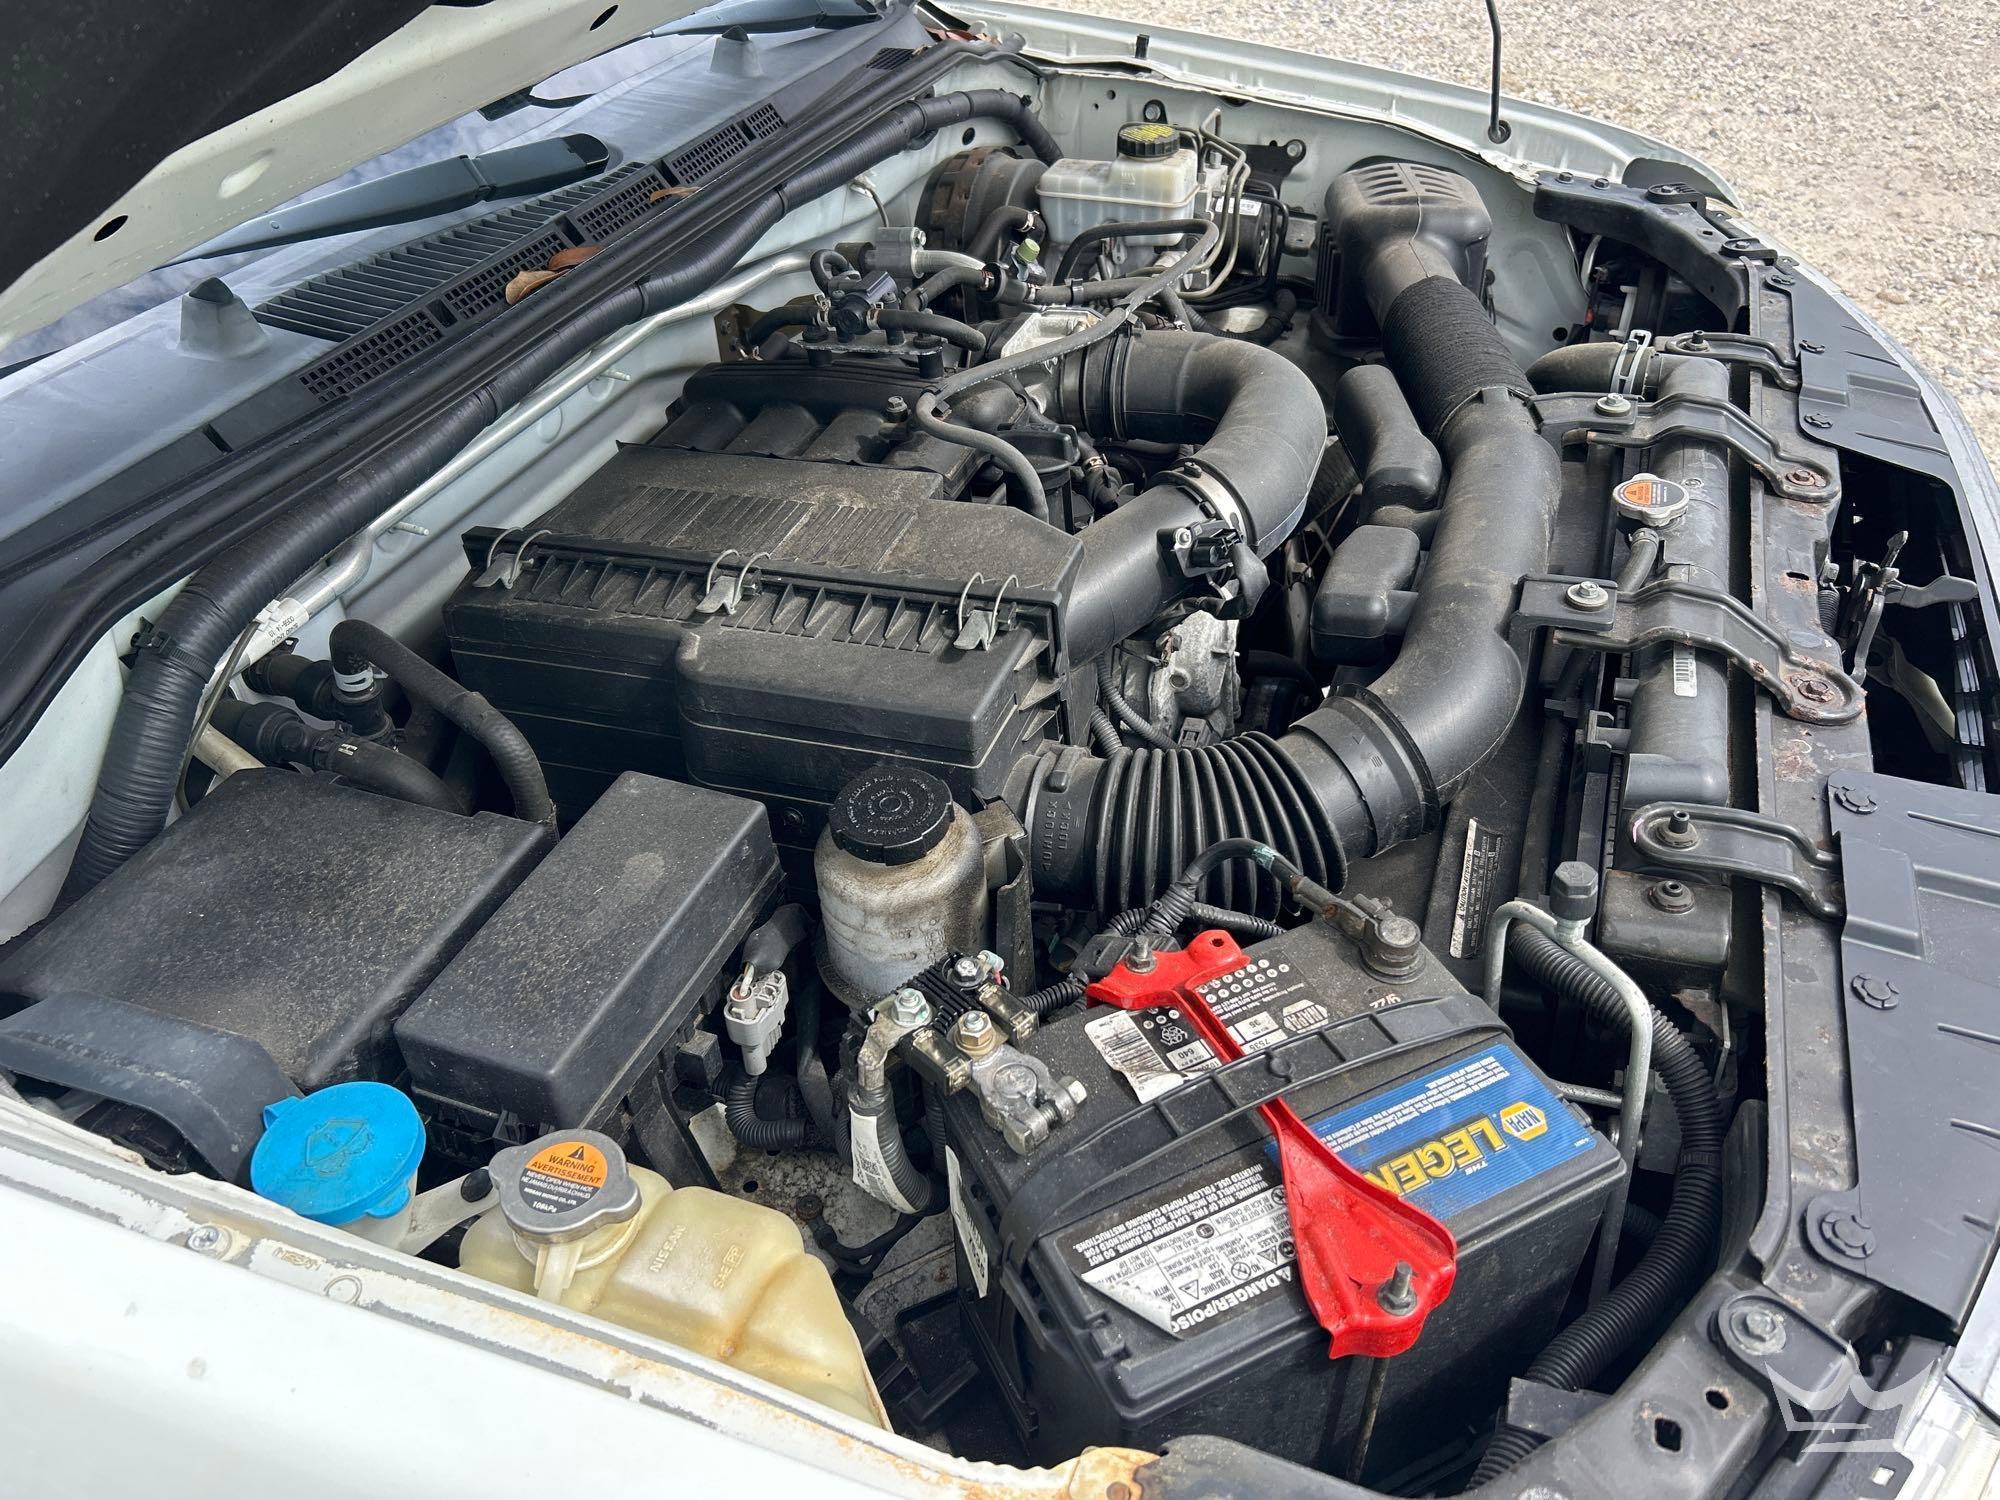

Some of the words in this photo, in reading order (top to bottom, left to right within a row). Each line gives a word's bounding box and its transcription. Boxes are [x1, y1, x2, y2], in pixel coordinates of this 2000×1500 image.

[1285, 1004, 1325, 1030] NAPA
[1504, 1108, 1542, 1132] NAPA
[530, 1161, 601, 1185] AVERTISSEMENT
[549, 1154, 595, 1173] WARNING
[1462, 1160, 1489, 1175] THE
[649, 1224, 687, 1273] NISSAN
